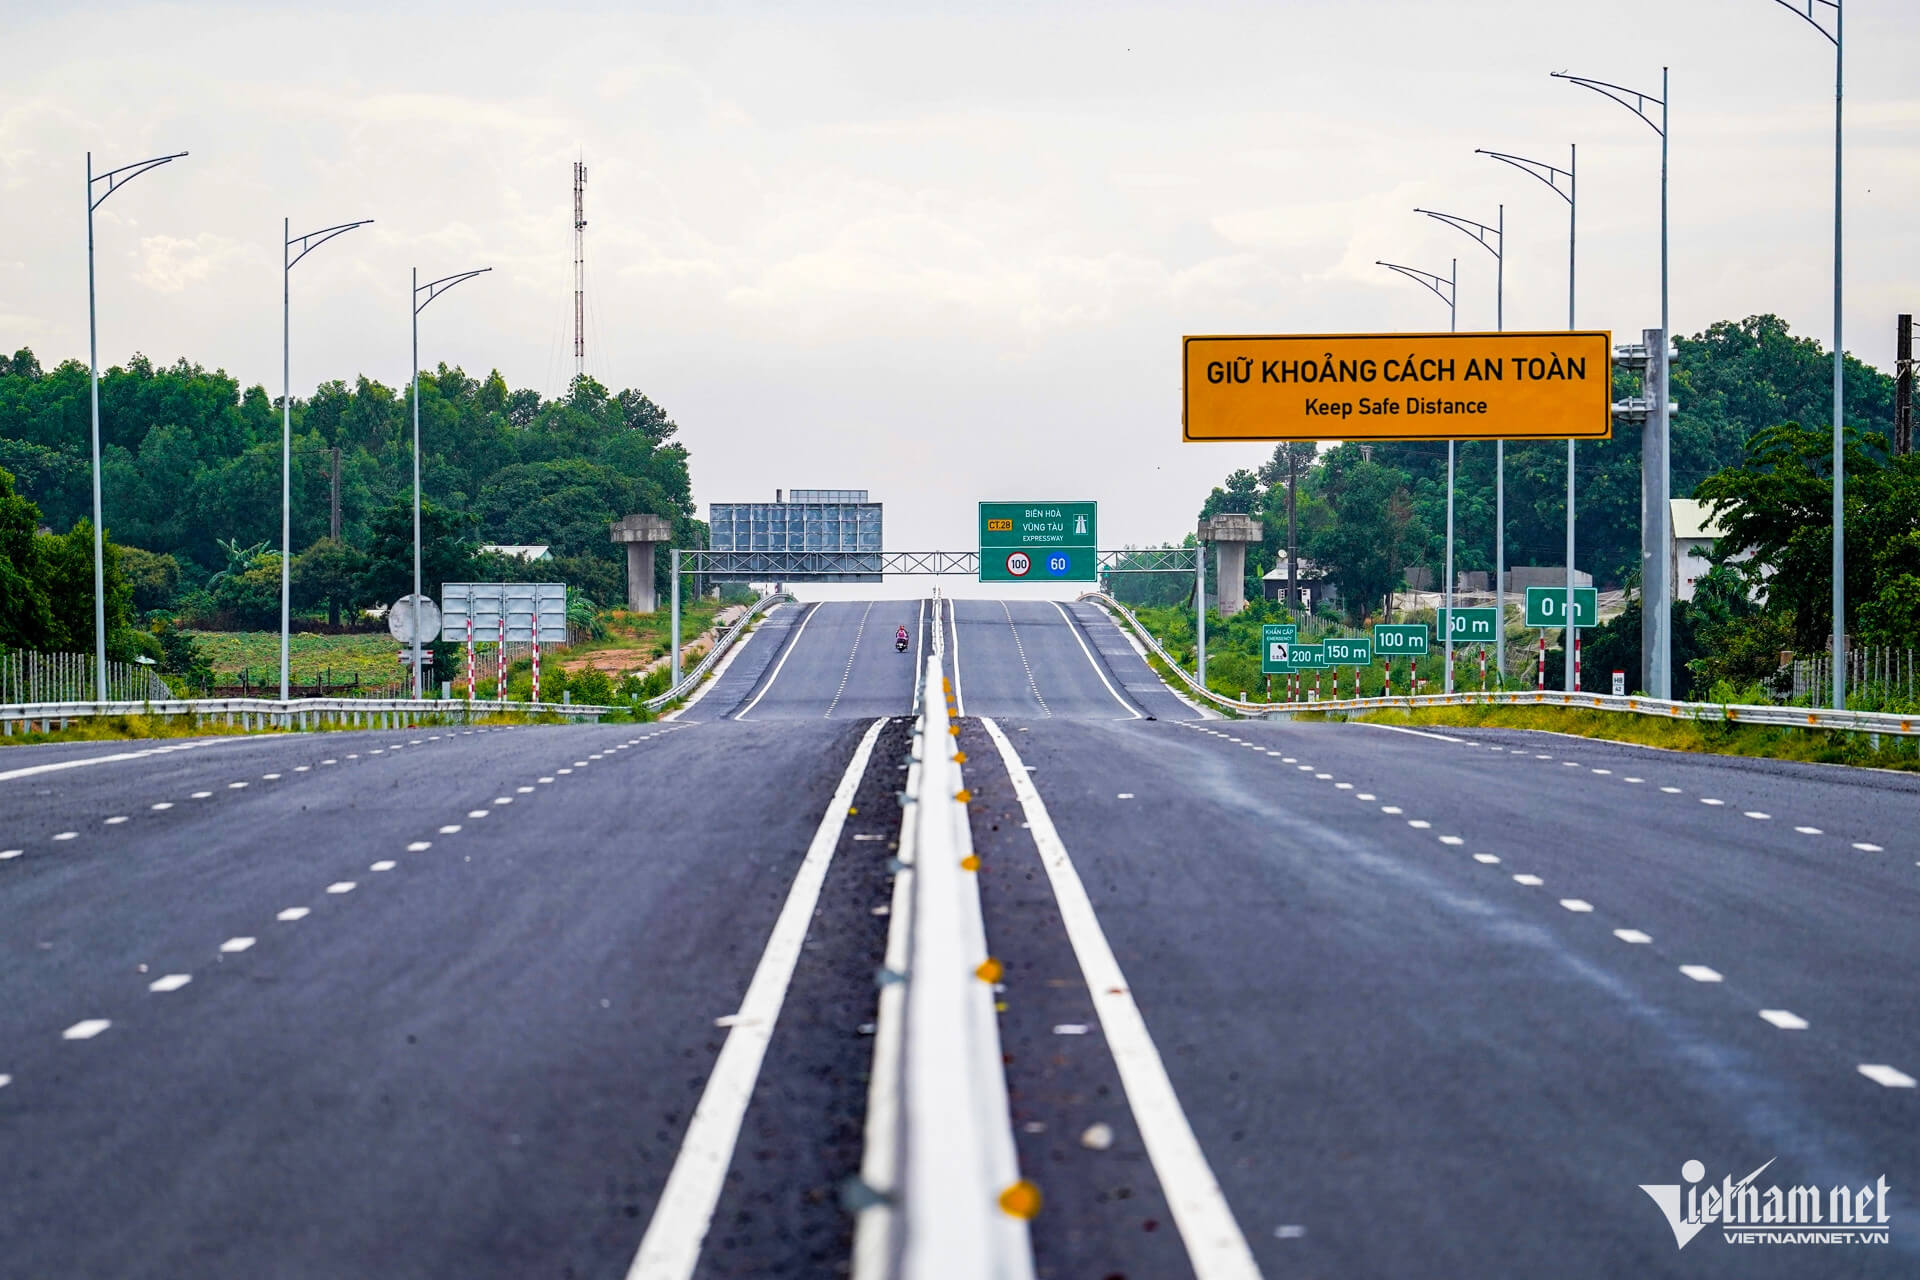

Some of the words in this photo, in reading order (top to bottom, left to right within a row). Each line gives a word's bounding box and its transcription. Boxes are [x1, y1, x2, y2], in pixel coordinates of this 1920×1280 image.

[1207, 356, 1254, 384] GIỮ
[1262, 352, 1377, 383] KHOẢNG
[1383, 353, 1454, 382] CÁCH
[1464, 358, 1503, 381] AN
[1511, 352, 1586, 380] TOÀN
[1305, 398, 1353, 419] Keep
[1358, 398, 1400, 415] Safe
[1406, 397, 1488, 414] Distance
[989, 521, 1011, 529] CT.28
[1022, 522, 1046, 532] VŨNG
[1047, 521, 1064, 532] TÀU
[1012, 559, 1027, 569] 100
[1050, 558, 1066, 570] 60
[1541, 597, 1554, 616] 0
[1472, 620, 1489, 632] m
[1379, 632, 1403, 647] 100
[1408, 636, 1423, 647] m
[1292, 650, 1311, 662] 200
[1328, 645, 1349, 658] 150
[1353, 648, 1367, 658] m
